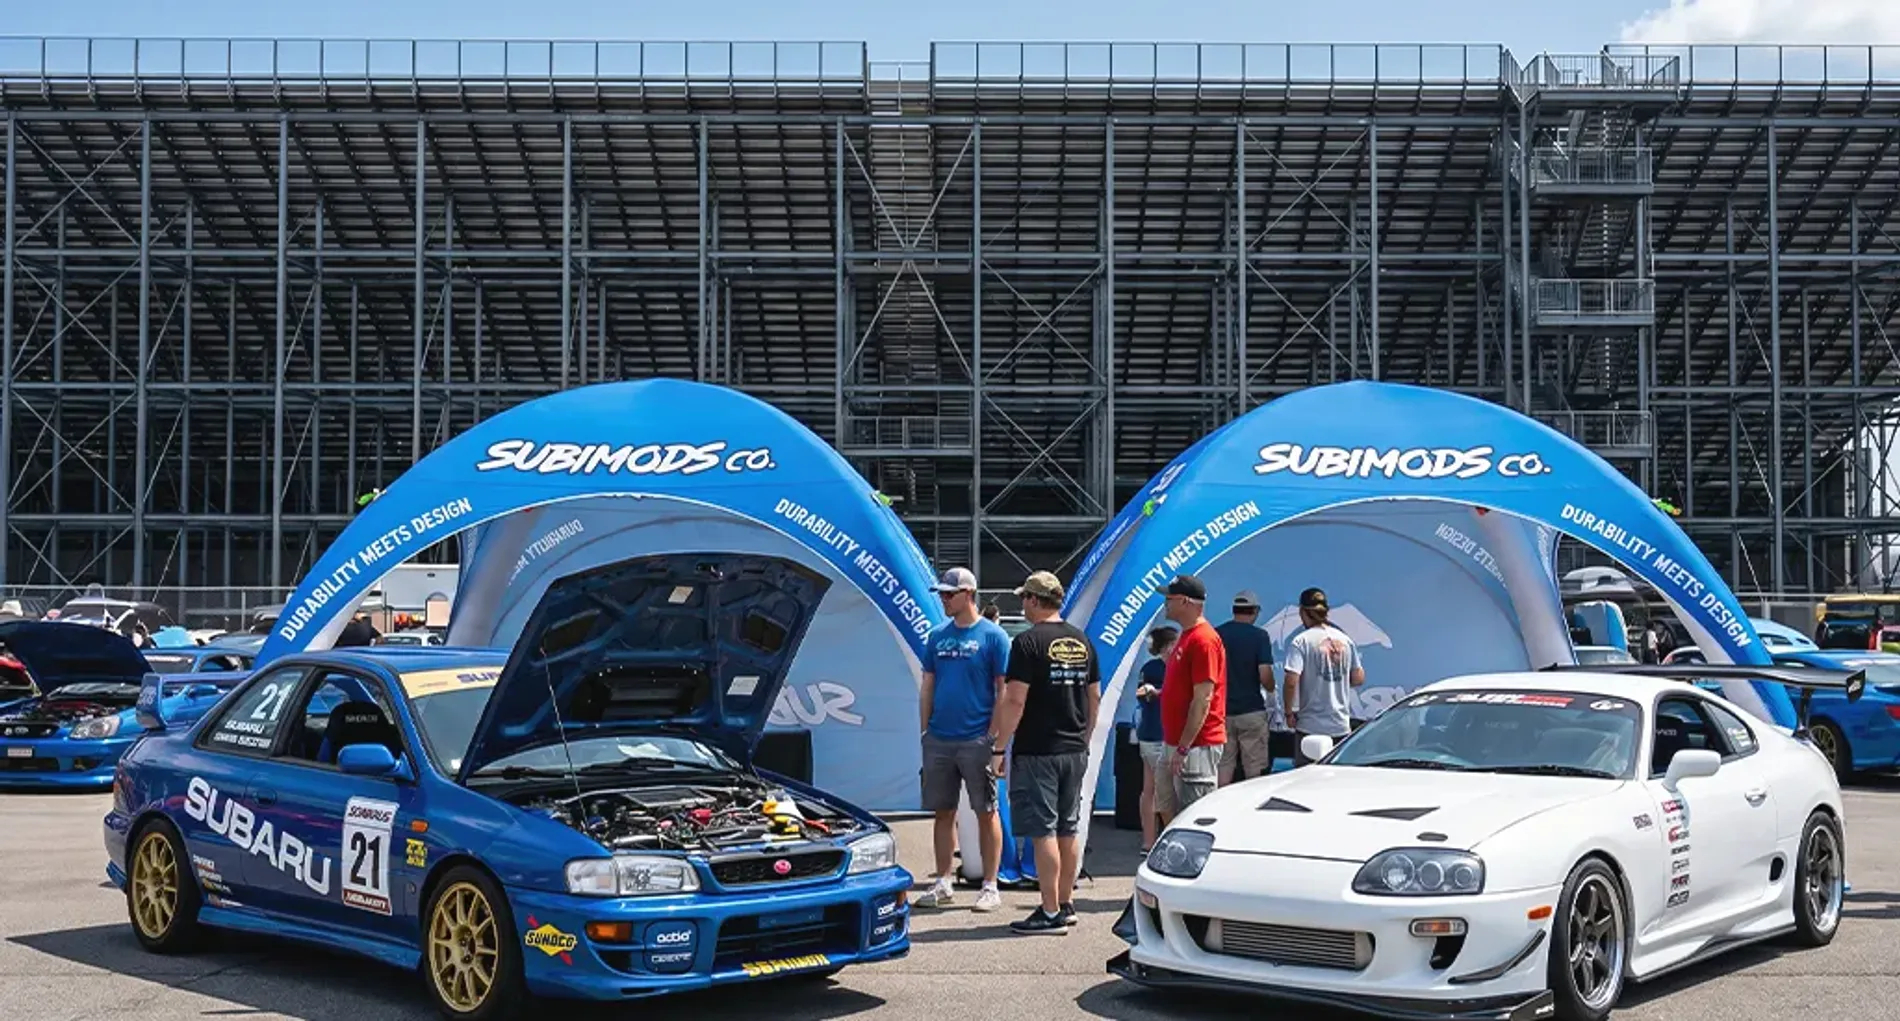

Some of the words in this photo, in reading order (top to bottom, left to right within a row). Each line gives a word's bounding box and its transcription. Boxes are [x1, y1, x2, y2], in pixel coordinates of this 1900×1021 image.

[476, 439, 727, 475] SUBIMODS
[725, 447, 776, 473] CO.
[1254, 443, 1493, 478] SUBIMODS
[1497, 453, 1552, 477] CO.
[280, 557, 361, 642] DURABILITY
[358, 525, 412, 566] MEETS
[411, 497, 472, 534] DESIGN
[774, 498, 860, 556] DURABILITY
[854, 549, 899, 595] MEETS
[1100, 562, 1167, 647] DURABILITY
[1163, 529, 1210, 572] MEETS
[1206, 500, 1261, 540] DESIGN
[1560, 503, 1656, 560] DURABILITY
[1652, 552, 1704, 598] MEETS
[1700, 592, 1752, 648] DESIGN
[224, 719, 265, 734] SUBARU
[251, 682, 294, 721] 21
[183, 776, 332, 896] SUBARU
[350, 831, 380, 890] 21
[526, 931, 575, 949] SUNOCO
